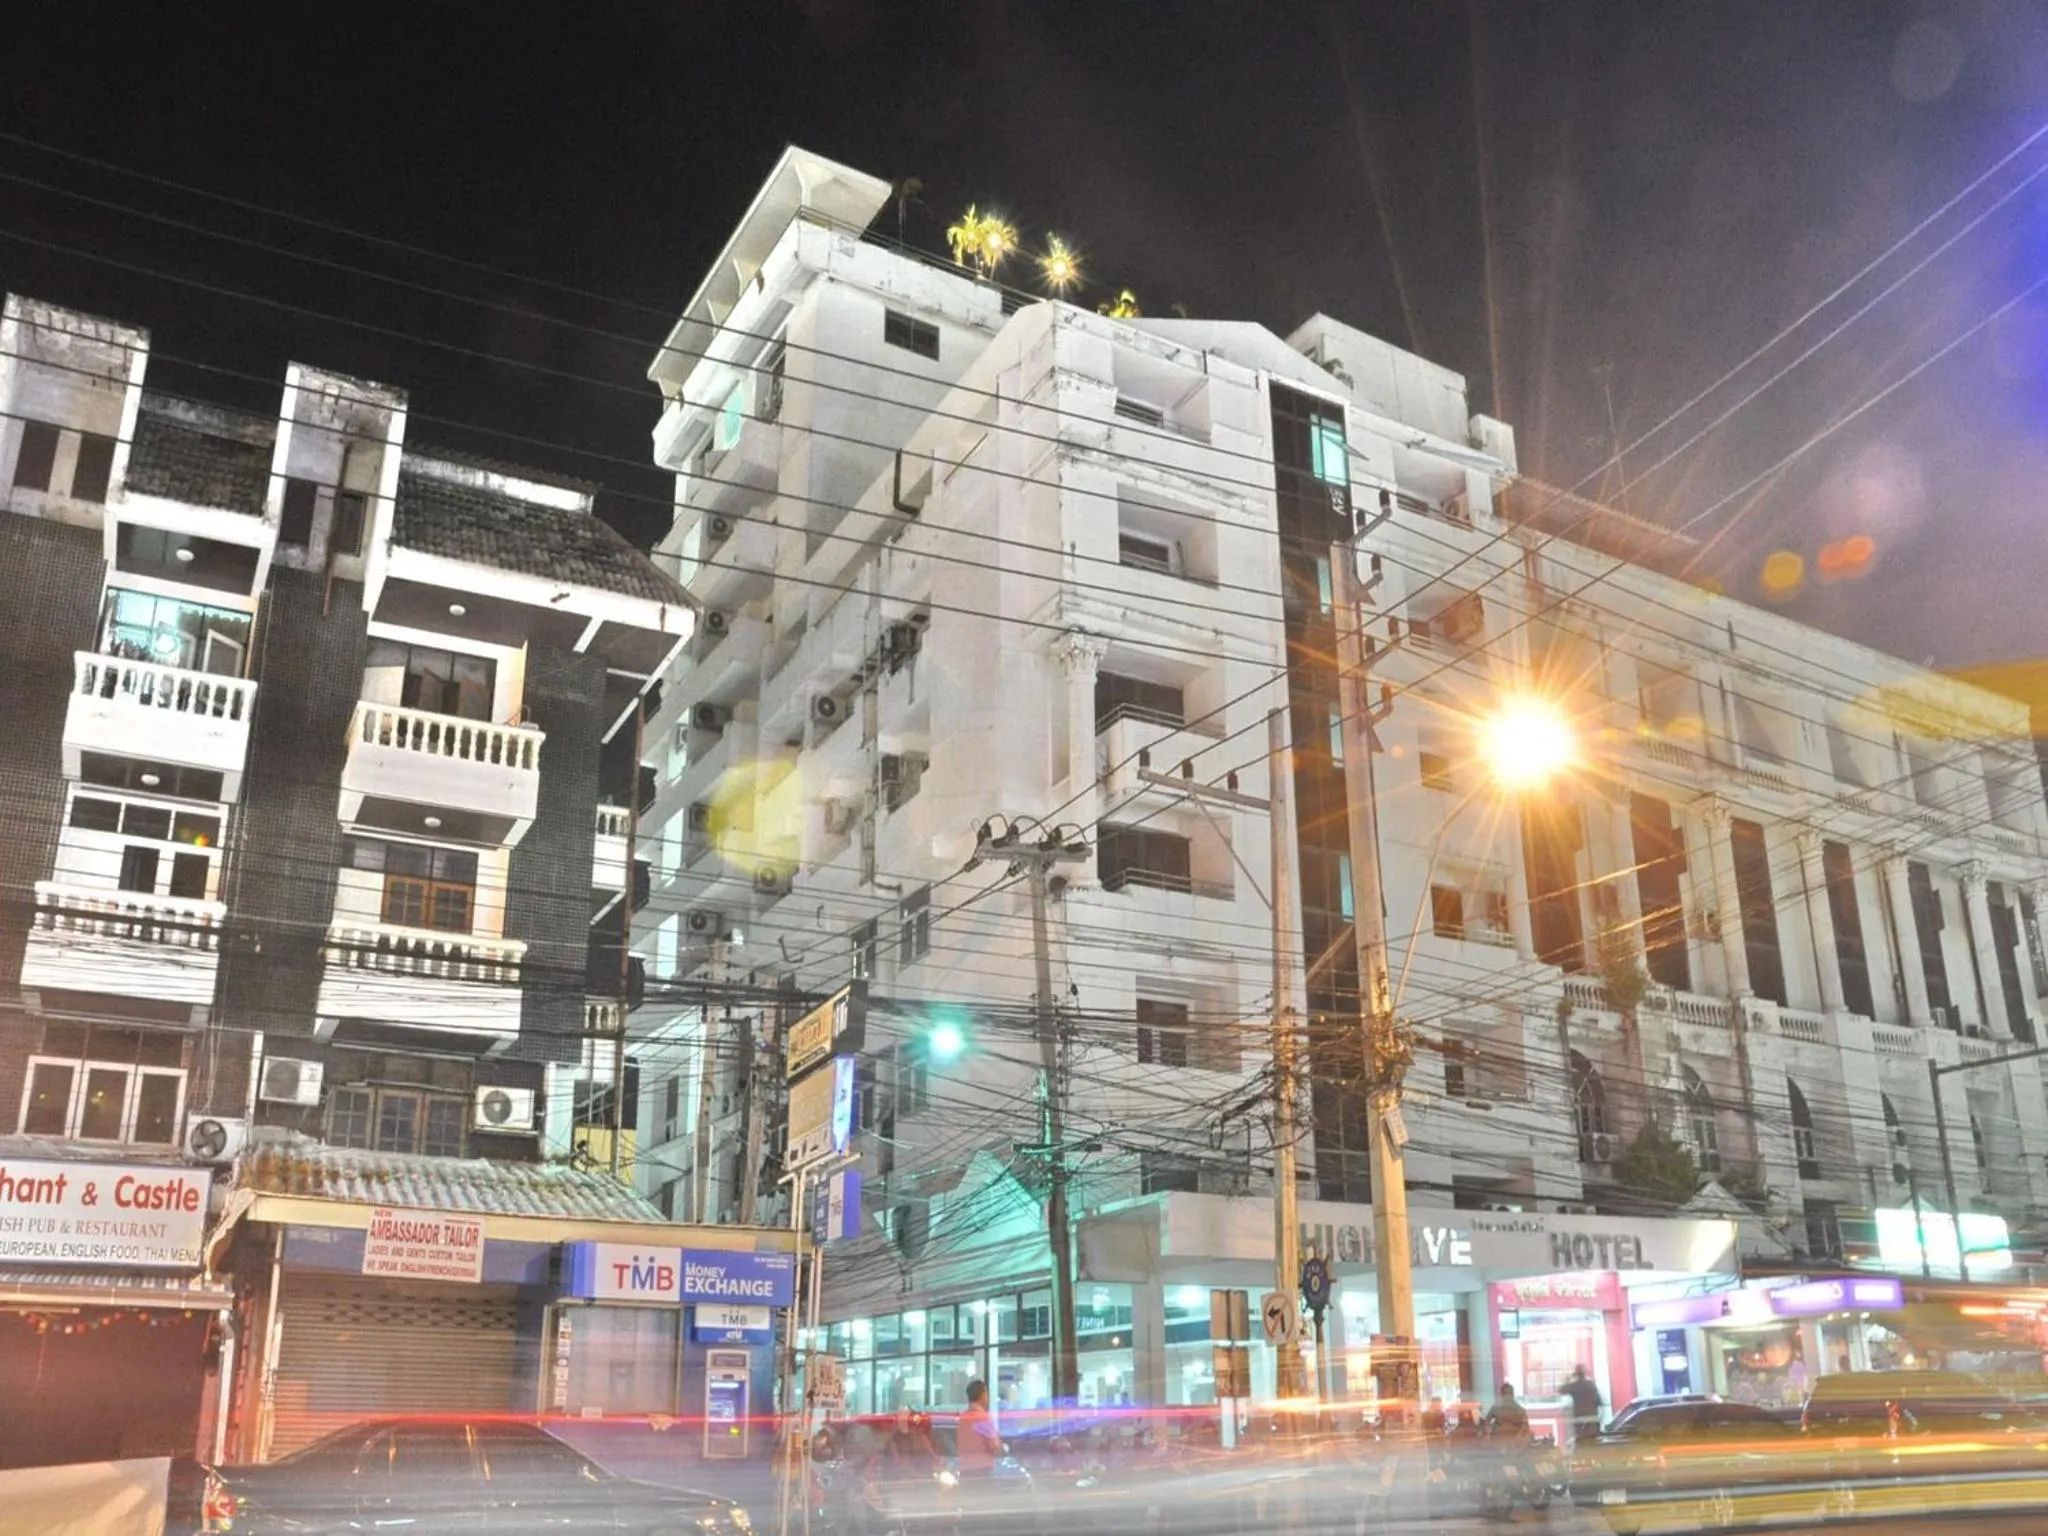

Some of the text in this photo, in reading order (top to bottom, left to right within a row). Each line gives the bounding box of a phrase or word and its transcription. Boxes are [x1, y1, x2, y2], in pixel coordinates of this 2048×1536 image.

[0, 1167, 199, 1212] hant & Castle
[28, 1217, 56, 1234] PUB
[59, 1219, 71, 1234] &
[75, 1220, 167, 1239] RESTAURANT
[370, 1219, 440, 1245] AMBASSADOR
[443, 1225, 479, 1248] TAILOR
[61, 1242, 107, 1258] ENGLISH
[1550, 1230, 1654, 1270] HOTEL
[613, 1257, 674, 1291] TMB
[685, 1262, 726, 1277] MONEY
[685, 1276, 773, 1297] EXCHANGE
[720, 1311, 748, 1325] TMB
